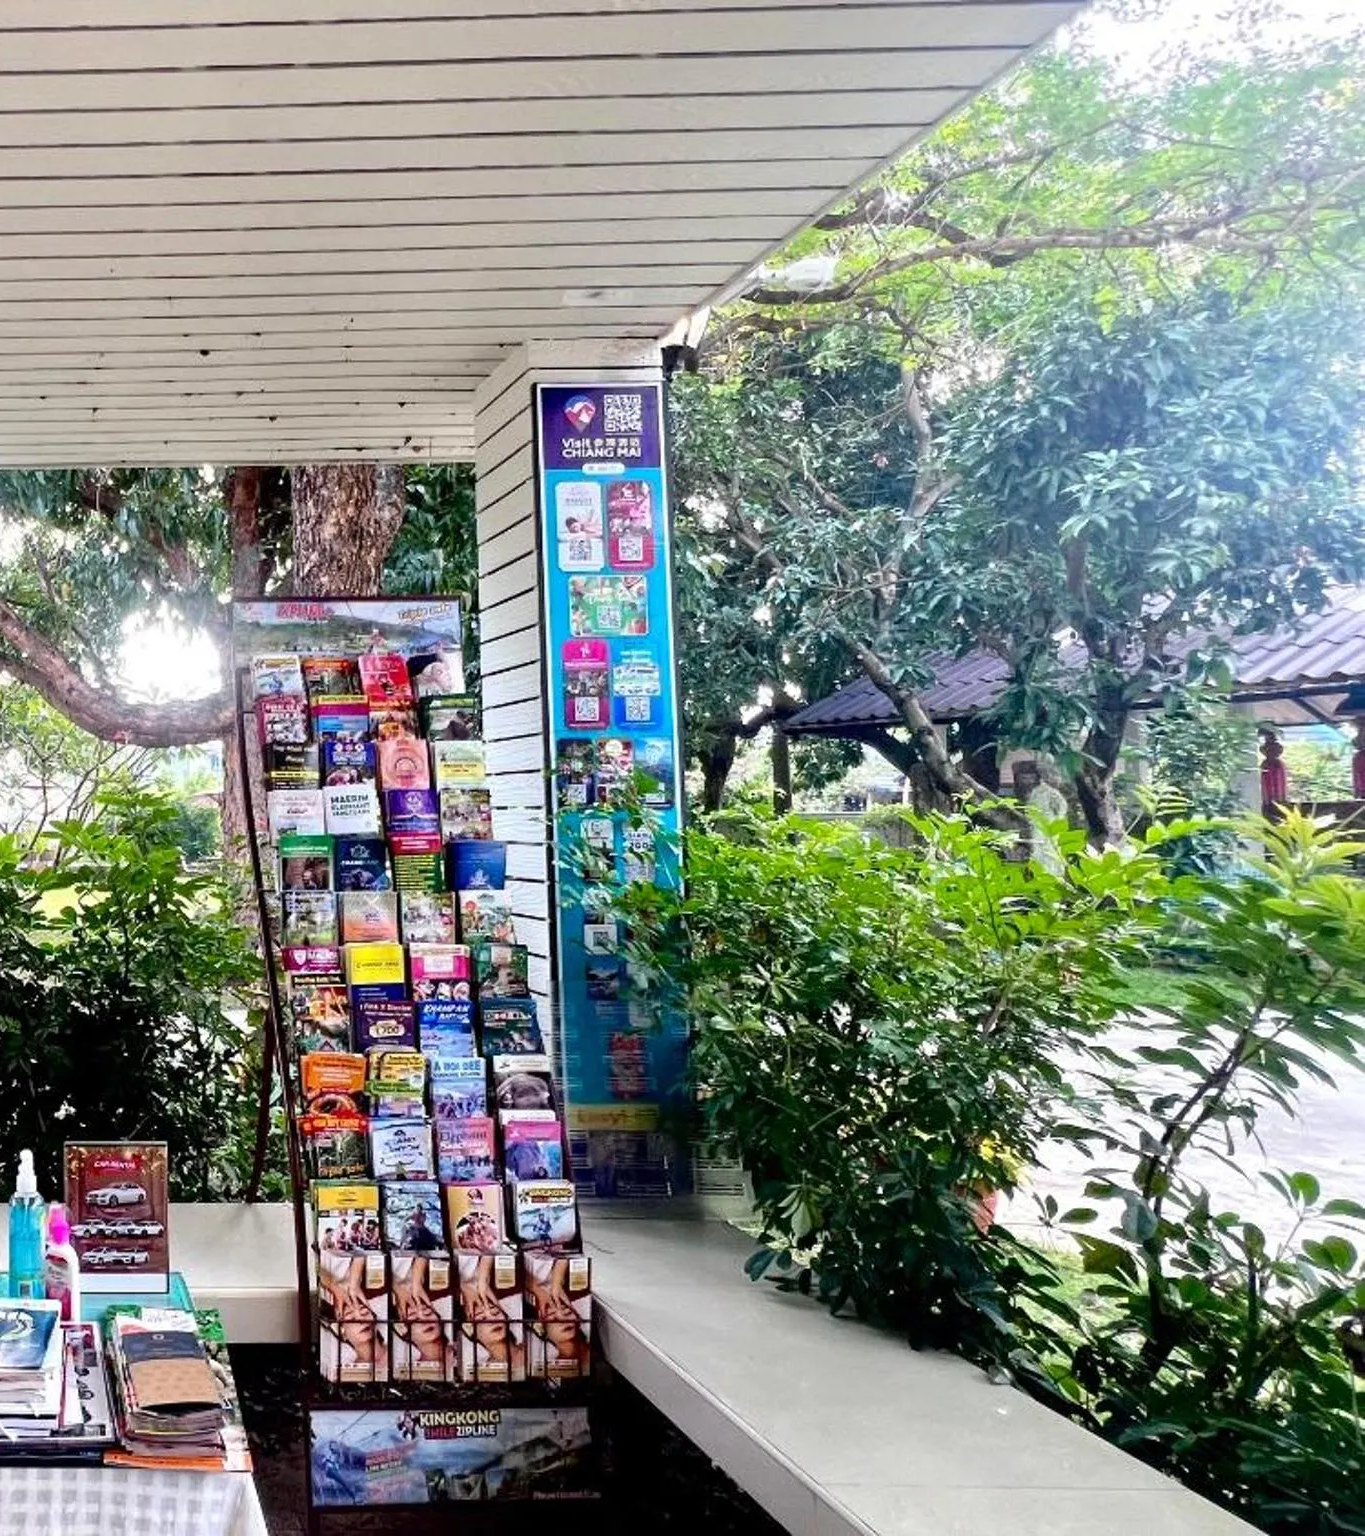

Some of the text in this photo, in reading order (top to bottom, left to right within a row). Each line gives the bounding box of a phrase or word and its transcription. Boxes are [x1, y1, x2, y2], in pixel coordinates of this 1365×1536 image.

[561, 438, 591, 449] Visit
[561, 447, 642, 458] CHIANG MAI
[418, 1409, 501, 1427] KINGKONG
